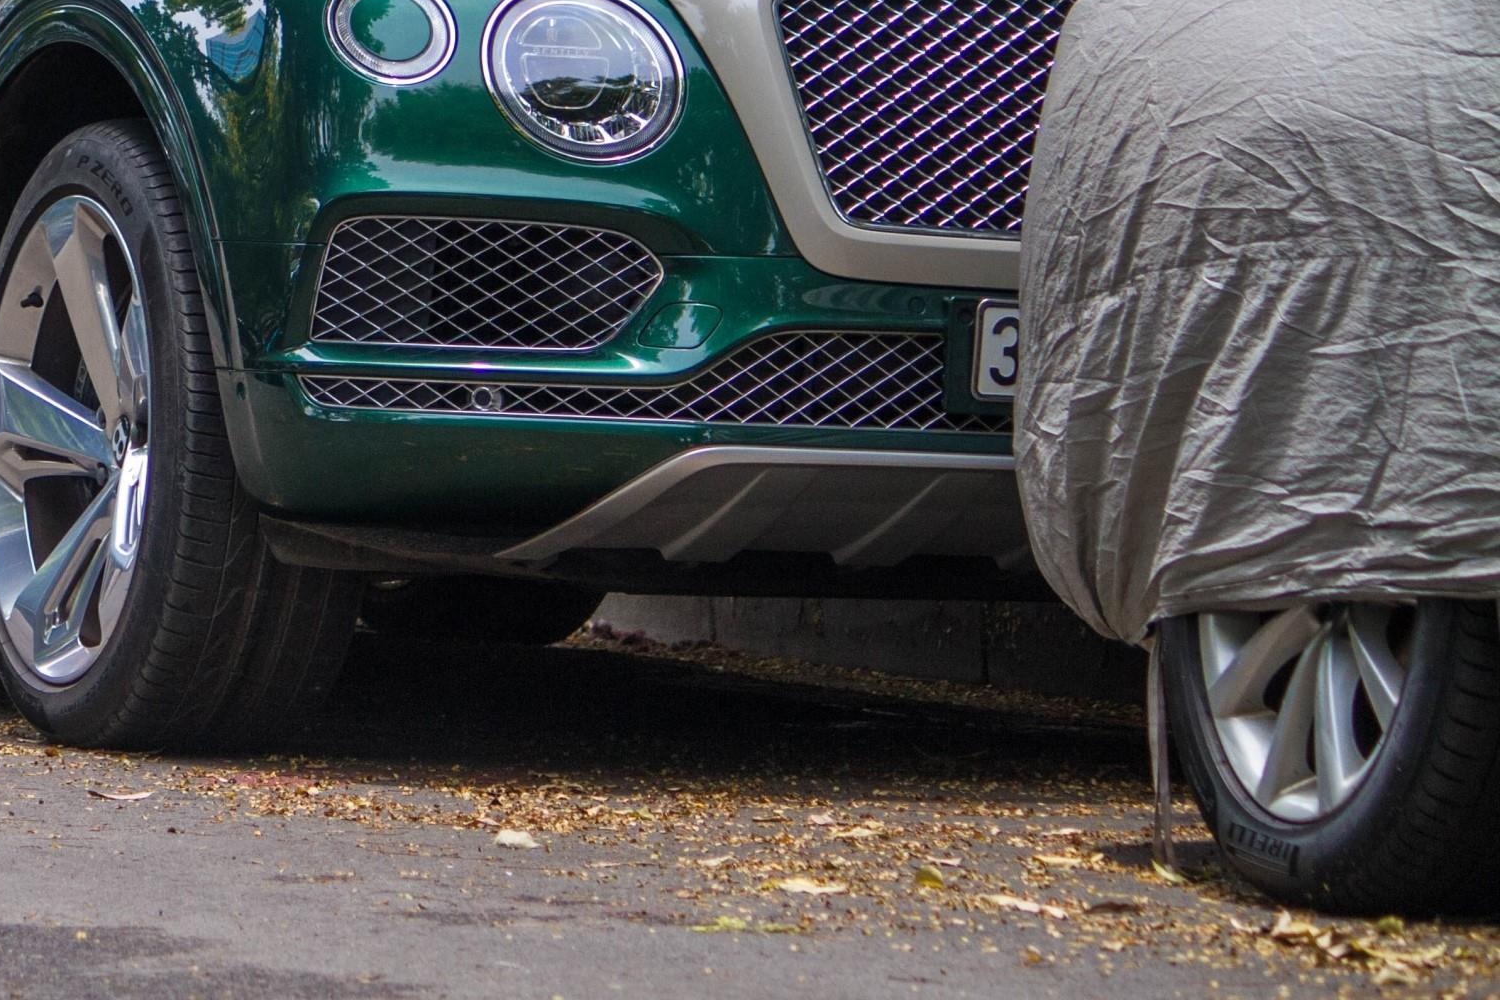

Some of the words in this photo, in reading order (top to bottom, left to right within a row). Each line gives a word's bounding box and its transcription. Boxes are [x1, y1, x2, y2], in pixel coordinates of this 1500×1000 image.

[76, 154, 90, 168] P
[90, 160, 134, 216] ZERO
[989, 316, 1019, 387] 3
[1227, 822, 1301, 877] PIRELLI
